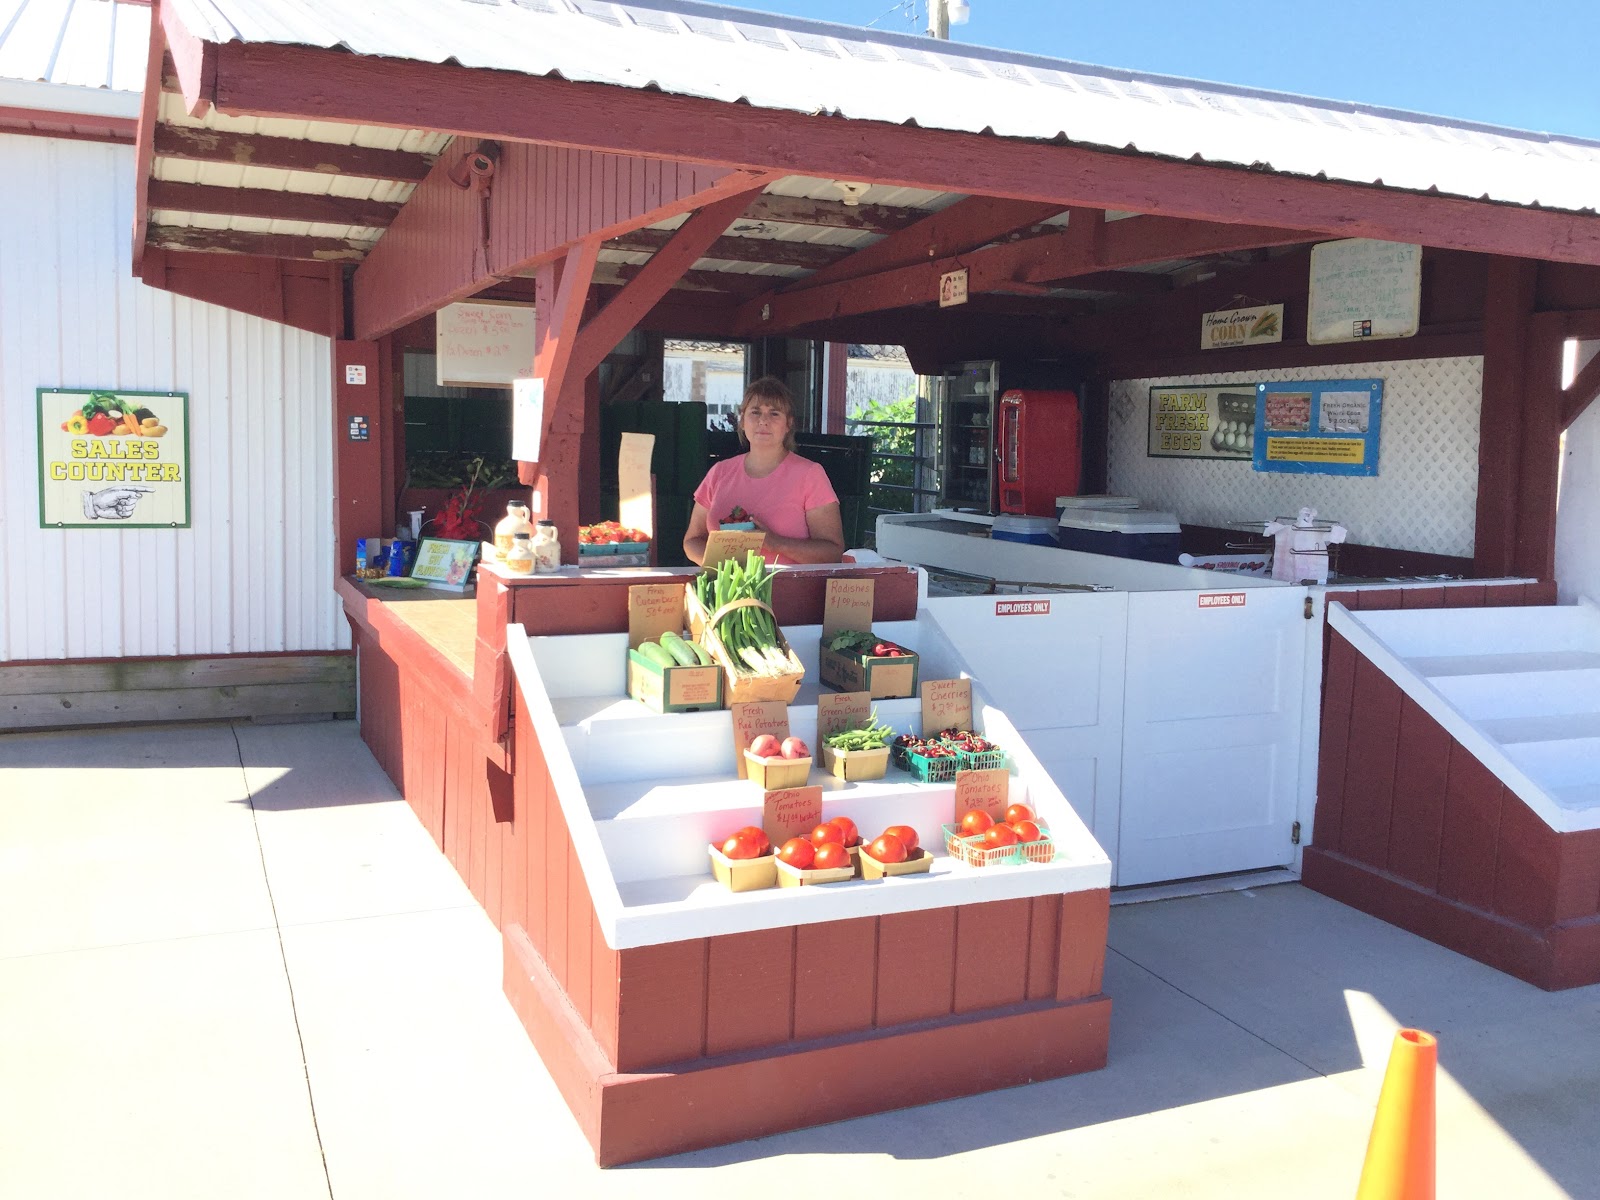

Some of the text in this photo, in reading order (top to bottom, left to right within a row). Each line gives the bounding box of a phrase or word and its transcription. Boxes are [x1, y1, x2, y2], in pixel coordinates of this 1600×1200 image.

[1205, 311, 1258, 327] Home Grown
[1210, 323, 1247, 341] CORN
[1159, 393, 1207, 411] FARM
[1155, 412, 1209, 431] FRESH
[1160, 432, 1202, 450] EGGS
[71, 439, 159, 459] SALES
[50, 461, 182, 482] COUNTER
[713, 534, 737, 544] Green
[1200, 595, 1245, 606] EMPLOYEES ONLY
[997, 602, 1048, 613] EMPLOYEES ONLY
[930, 680, 957, 691] Sweet
[834, 694, 853, 703] Fresh
[930, 690, 968, 702] Cherries
[742, 703, 764, 716] Fresh
[820, 704, 868, 717] Green Beans
[737, 717, 789, 730] Red Potatoes
[971, 772, 990, 784] Ohio
[783, 791, 800, 800] Ohio
[959, 783, 1002, 795] Tomatoes
[774, 798, 812, 812] Tomatoes
